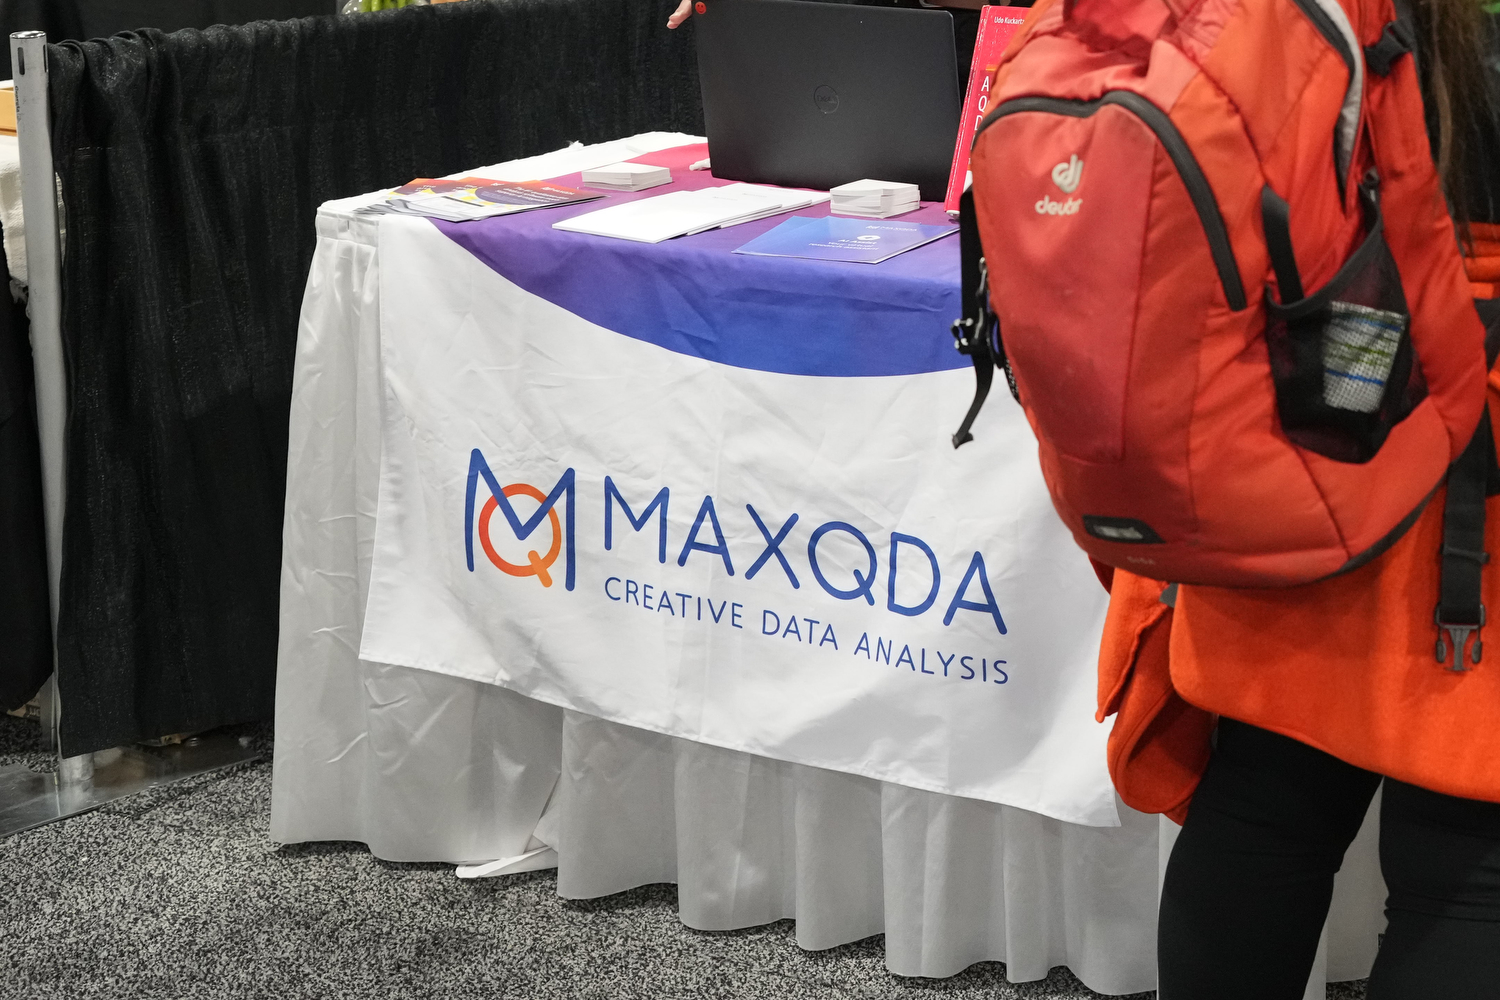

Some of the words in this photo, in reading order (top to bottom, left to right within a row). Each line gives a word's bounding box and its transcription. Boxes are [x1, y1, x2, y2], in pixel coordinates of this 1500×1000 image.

[994, 16, 1004, 24] Udo
[603, 475, 1009, 635] MAXQDA
[603, 575, 744, 630] CREATIVE
[761, 609, 840, 651] DATA
[853, 631, 1010, 686] ANALYSIS
